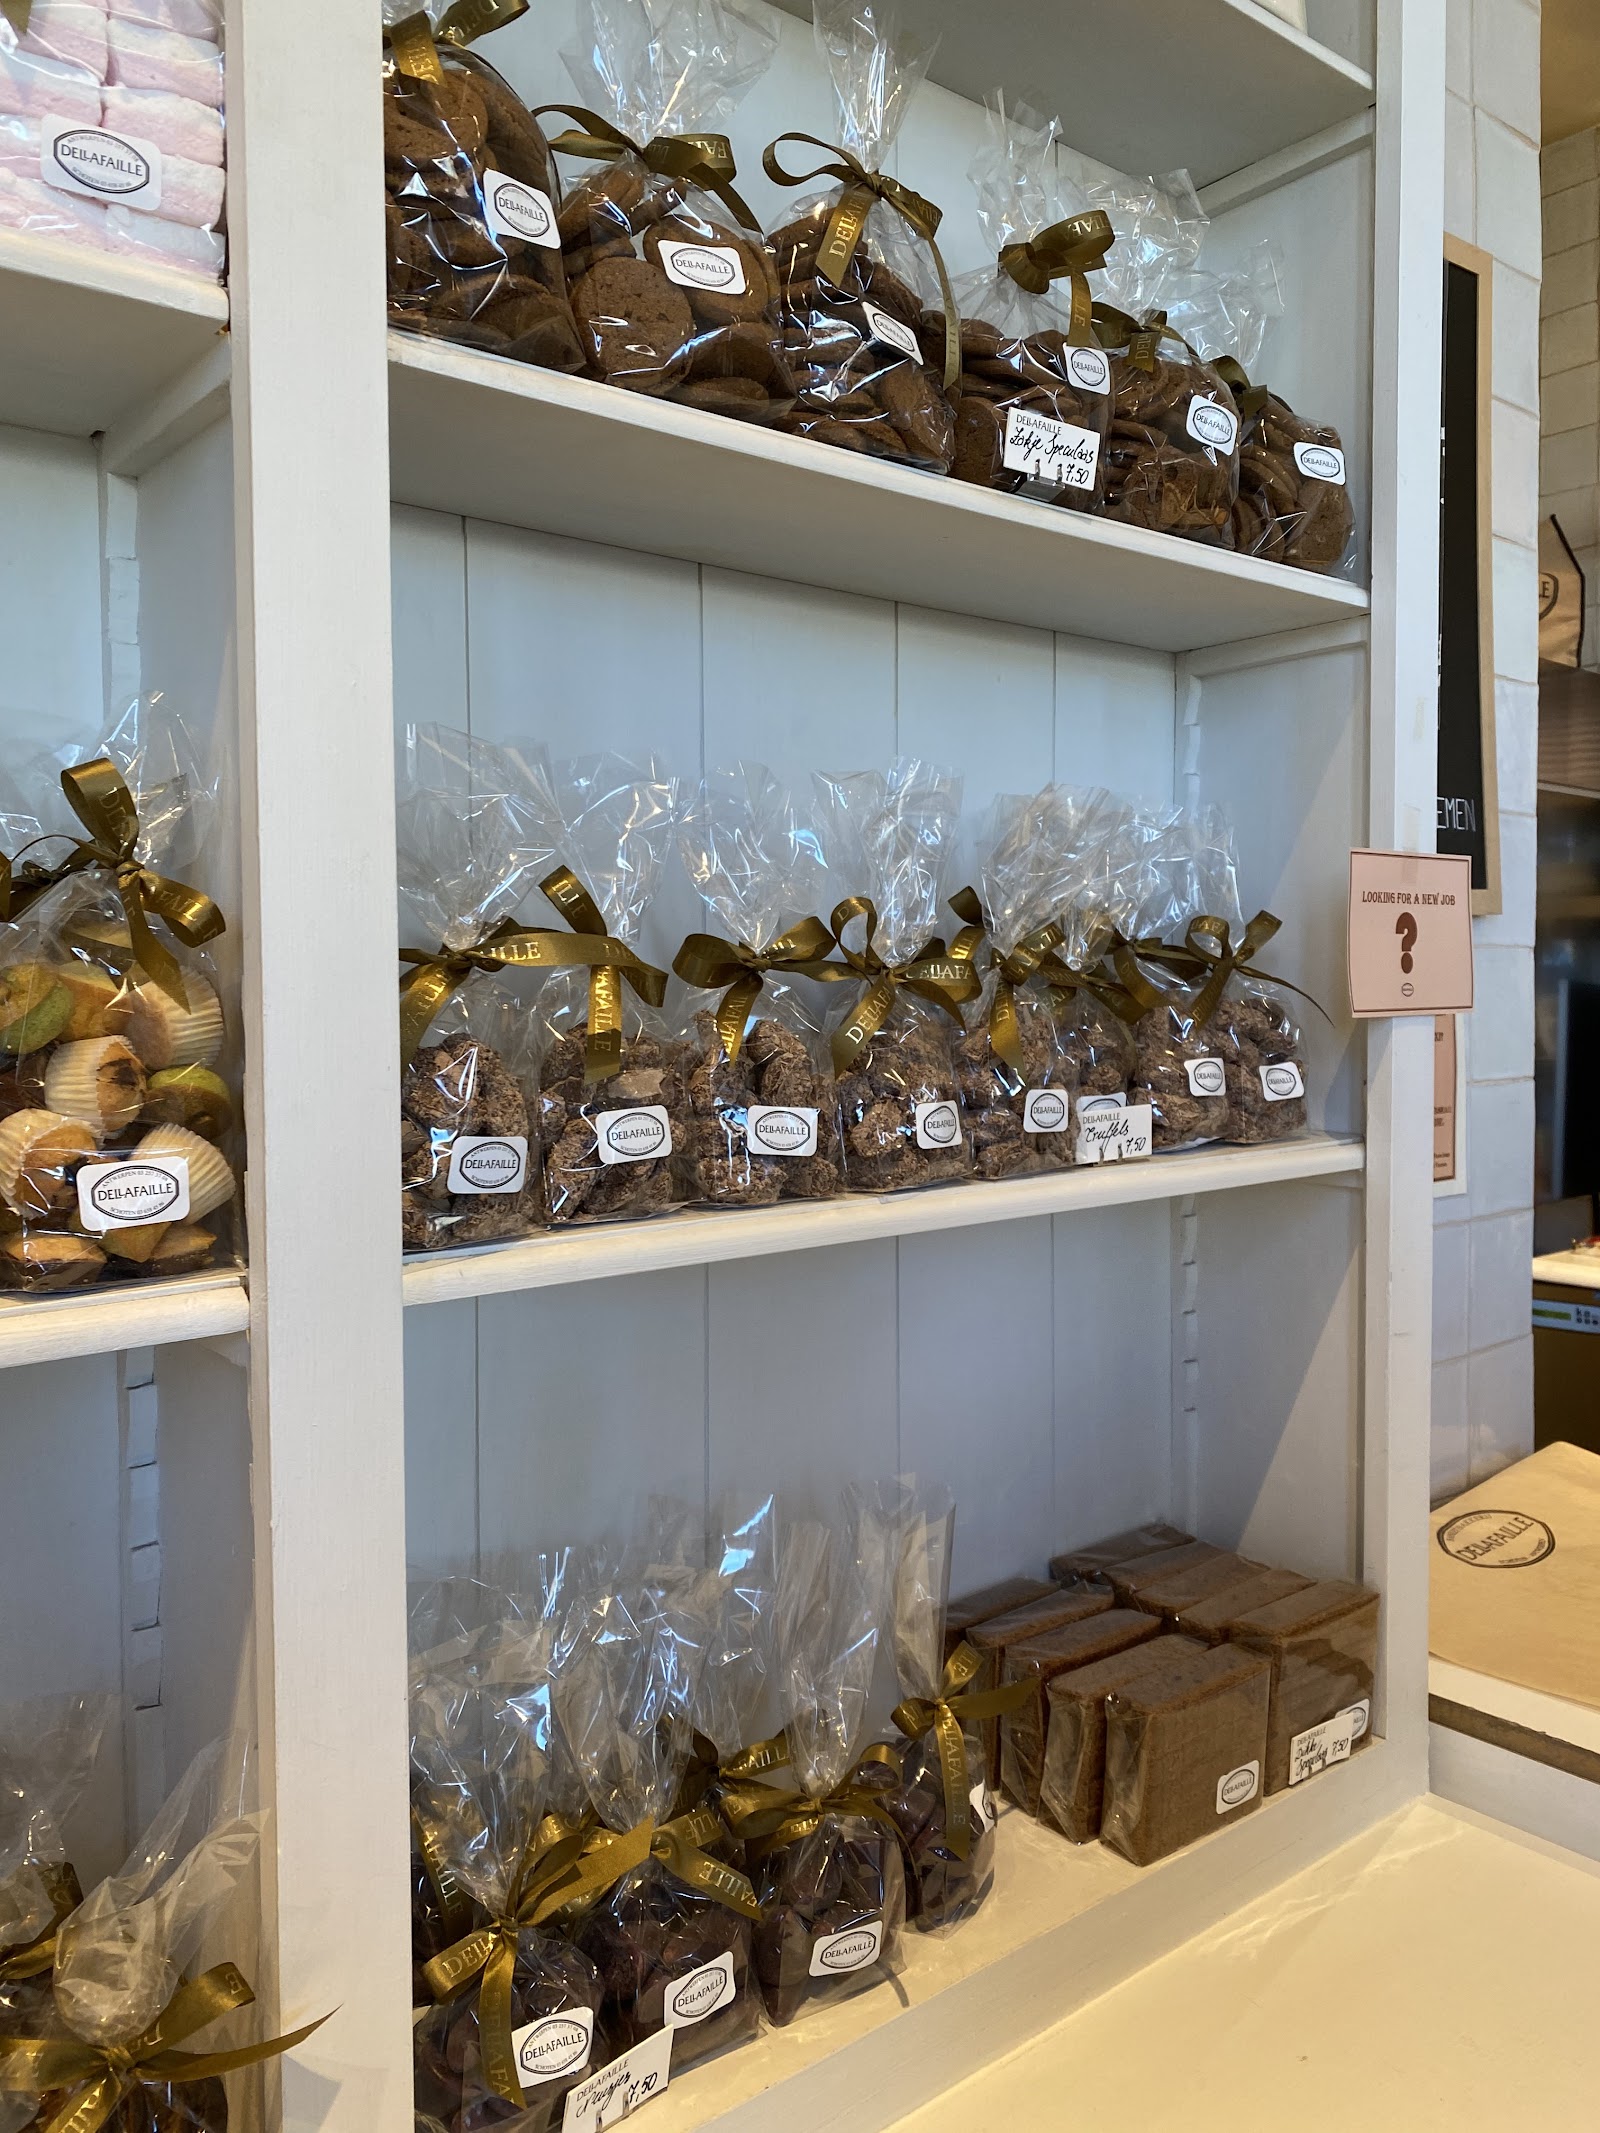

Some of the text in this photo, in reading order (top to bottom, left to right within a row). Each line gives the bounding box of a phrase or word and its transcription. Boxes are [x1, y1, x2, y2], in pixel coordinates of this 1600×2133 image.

[60, 143, 143, 177] DELLAFAILLE
[498, 196, 546, 223] DELLAFAILLE
[675, 256, 732, 275] DELLAFAILLE
[1072, 359, 1105, 376] DELLAFAILLE
[1015, 413, 1063, 436] DELLAFAILLE
[1194, 412, 1232, 438] DELLAFAILLE
[1043, 432, 1095, 465] Speculaas
[1303, 455, 1338, 470] DELLAFAILLE
[1065, 463, 1090, 485] 7,50
[1361, 890, 1456, 906] LOOKING FOR A NEW JOB
[1033, 1106, 1062, 1115] DELLAFAILLE
[1082, 1112, 1121, 1125] DELLAFAILLE
[611, 1126, 662, 1142] DELLAFAILLE
[759, 1123, 807, 1137] DELLAFAILLE
[1125, 1137, 1147, 1155] 7,50
[465, 1158, 517, 1170] DELLAFAILLE
[97, 1182, 174, 1202] DELLAFAILLE
[824, 1939, 873, 1959] DELLAFAILLE
[677, 1975, 724, 2008] DELLAFAILLE
[525, 2032, 585, 2062] DELLAFAILLE
[577, 2058, 630, 2102] DELLAFAILLE
[628, 2072, 659, 2104] 7,50
